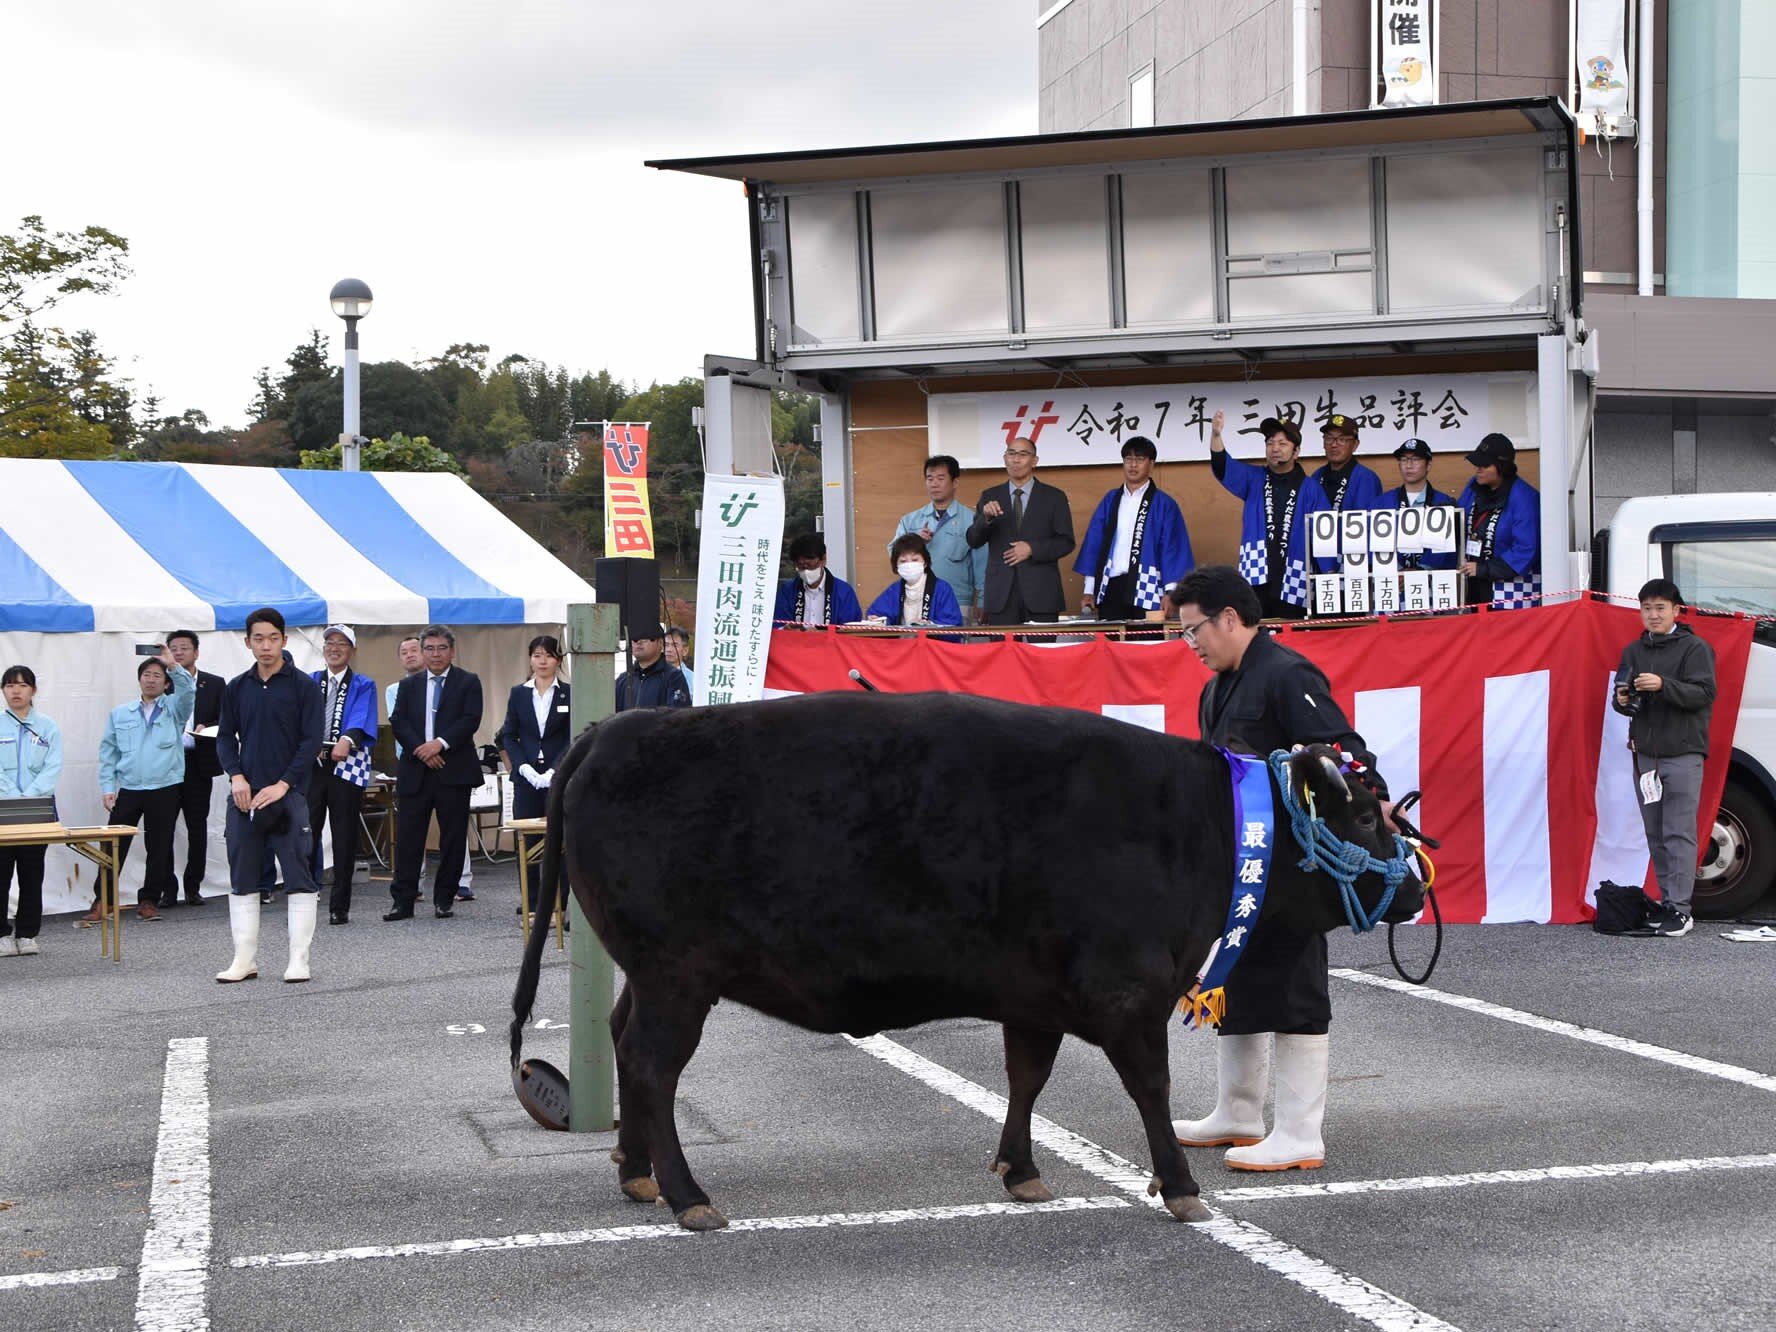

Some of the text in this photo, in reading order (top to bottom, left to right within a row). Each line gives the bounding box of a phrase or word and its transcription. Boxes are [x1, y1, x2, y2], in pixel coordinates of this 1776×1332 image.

[1321, 579, 1335, 612] 千万円
[1351, 578, 1363, 611] 百万円
[1381, 577, 1393, 610] 十万円
[1410, 584, 1423, 609] 万円
[1438, 583, 1451, 608] 千円
[1224, 822, 1268, 950] 最優秀賞
